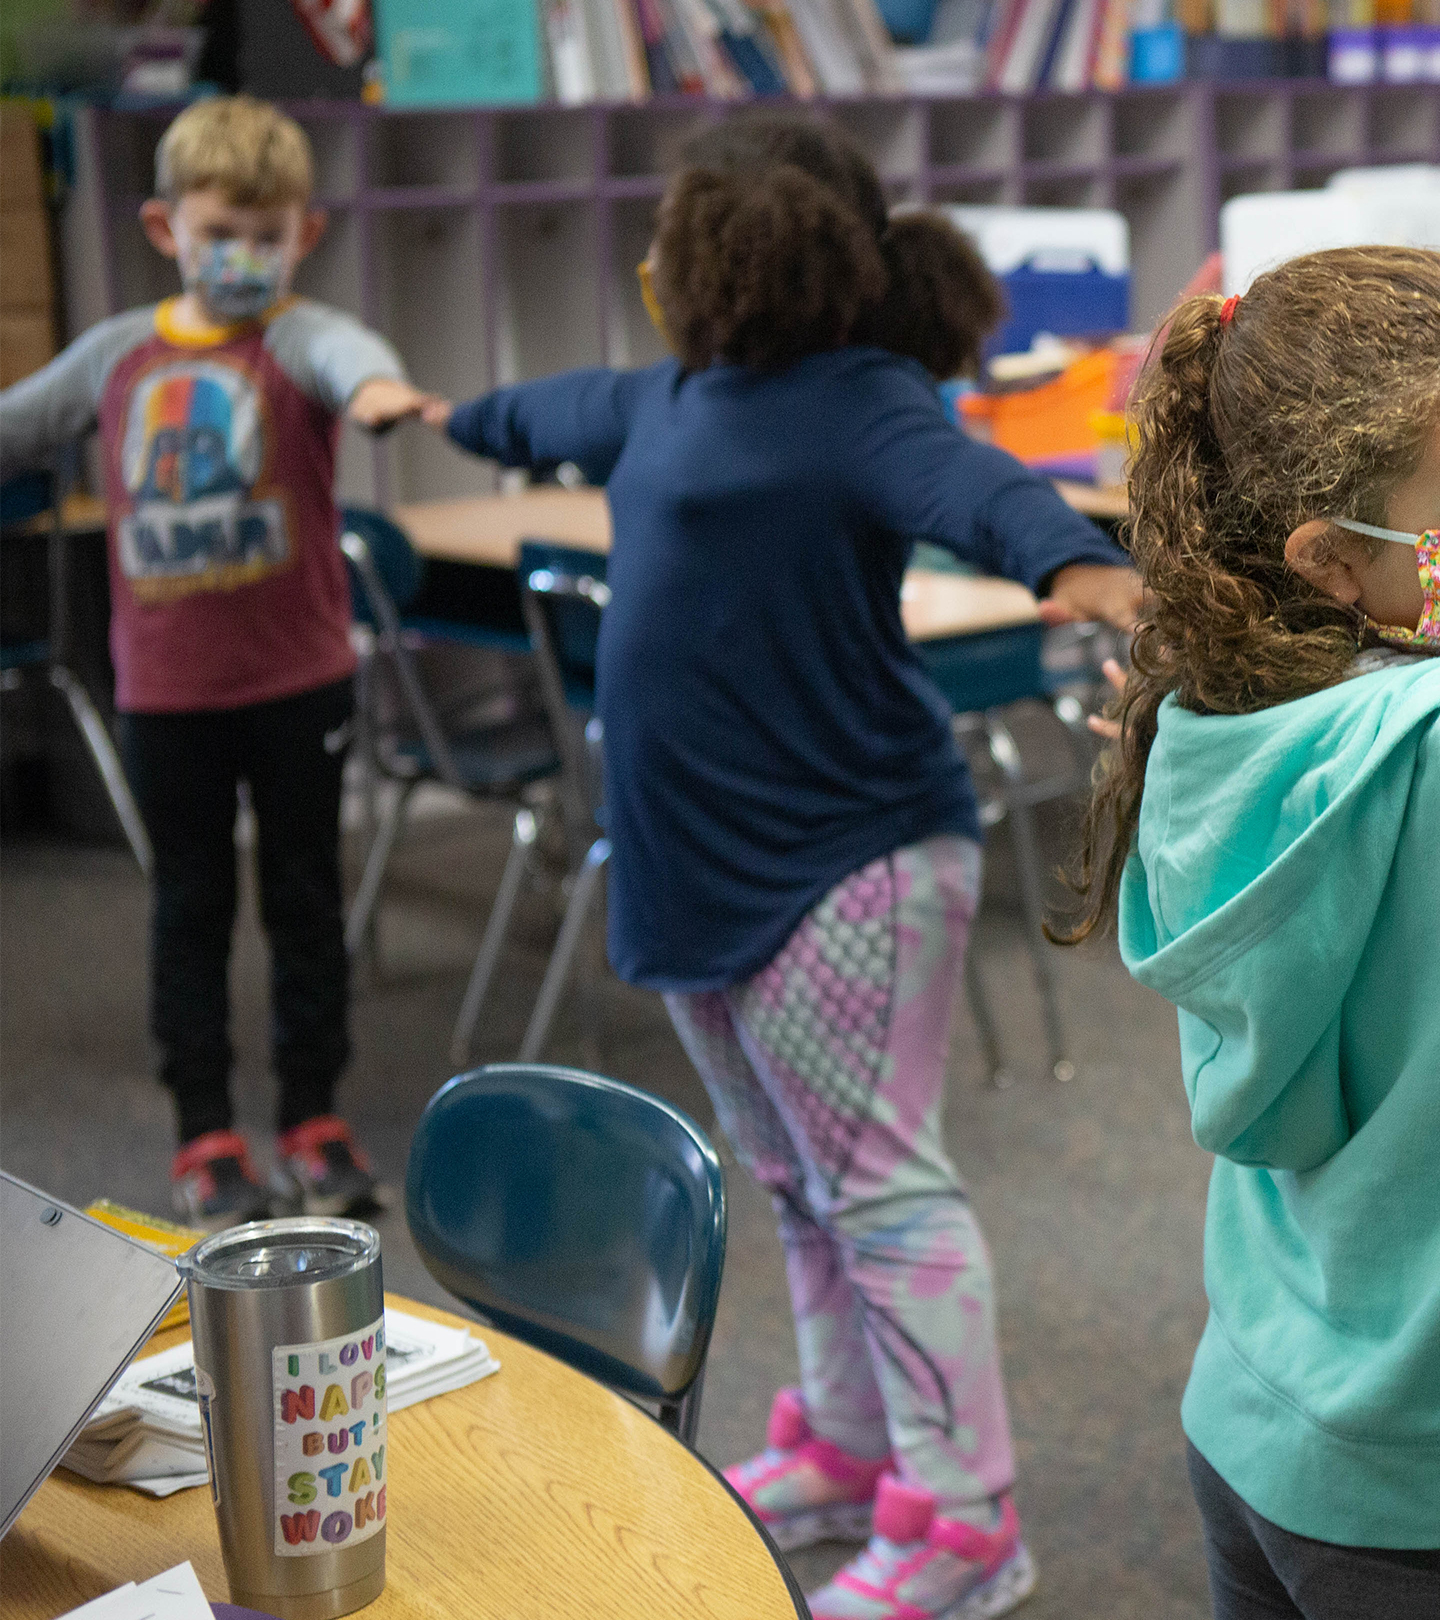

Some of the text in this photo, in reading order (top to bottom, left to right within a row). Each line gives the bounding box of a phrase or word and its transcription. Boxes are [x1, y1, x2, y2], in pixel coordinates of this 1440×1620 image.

[287, 1353, 300, 1377] I
[280, 1363, 386, 1425] NAPS
[302, 1420, 367, 1457] BUT
[287, 1444, 385, 1506] STAY
